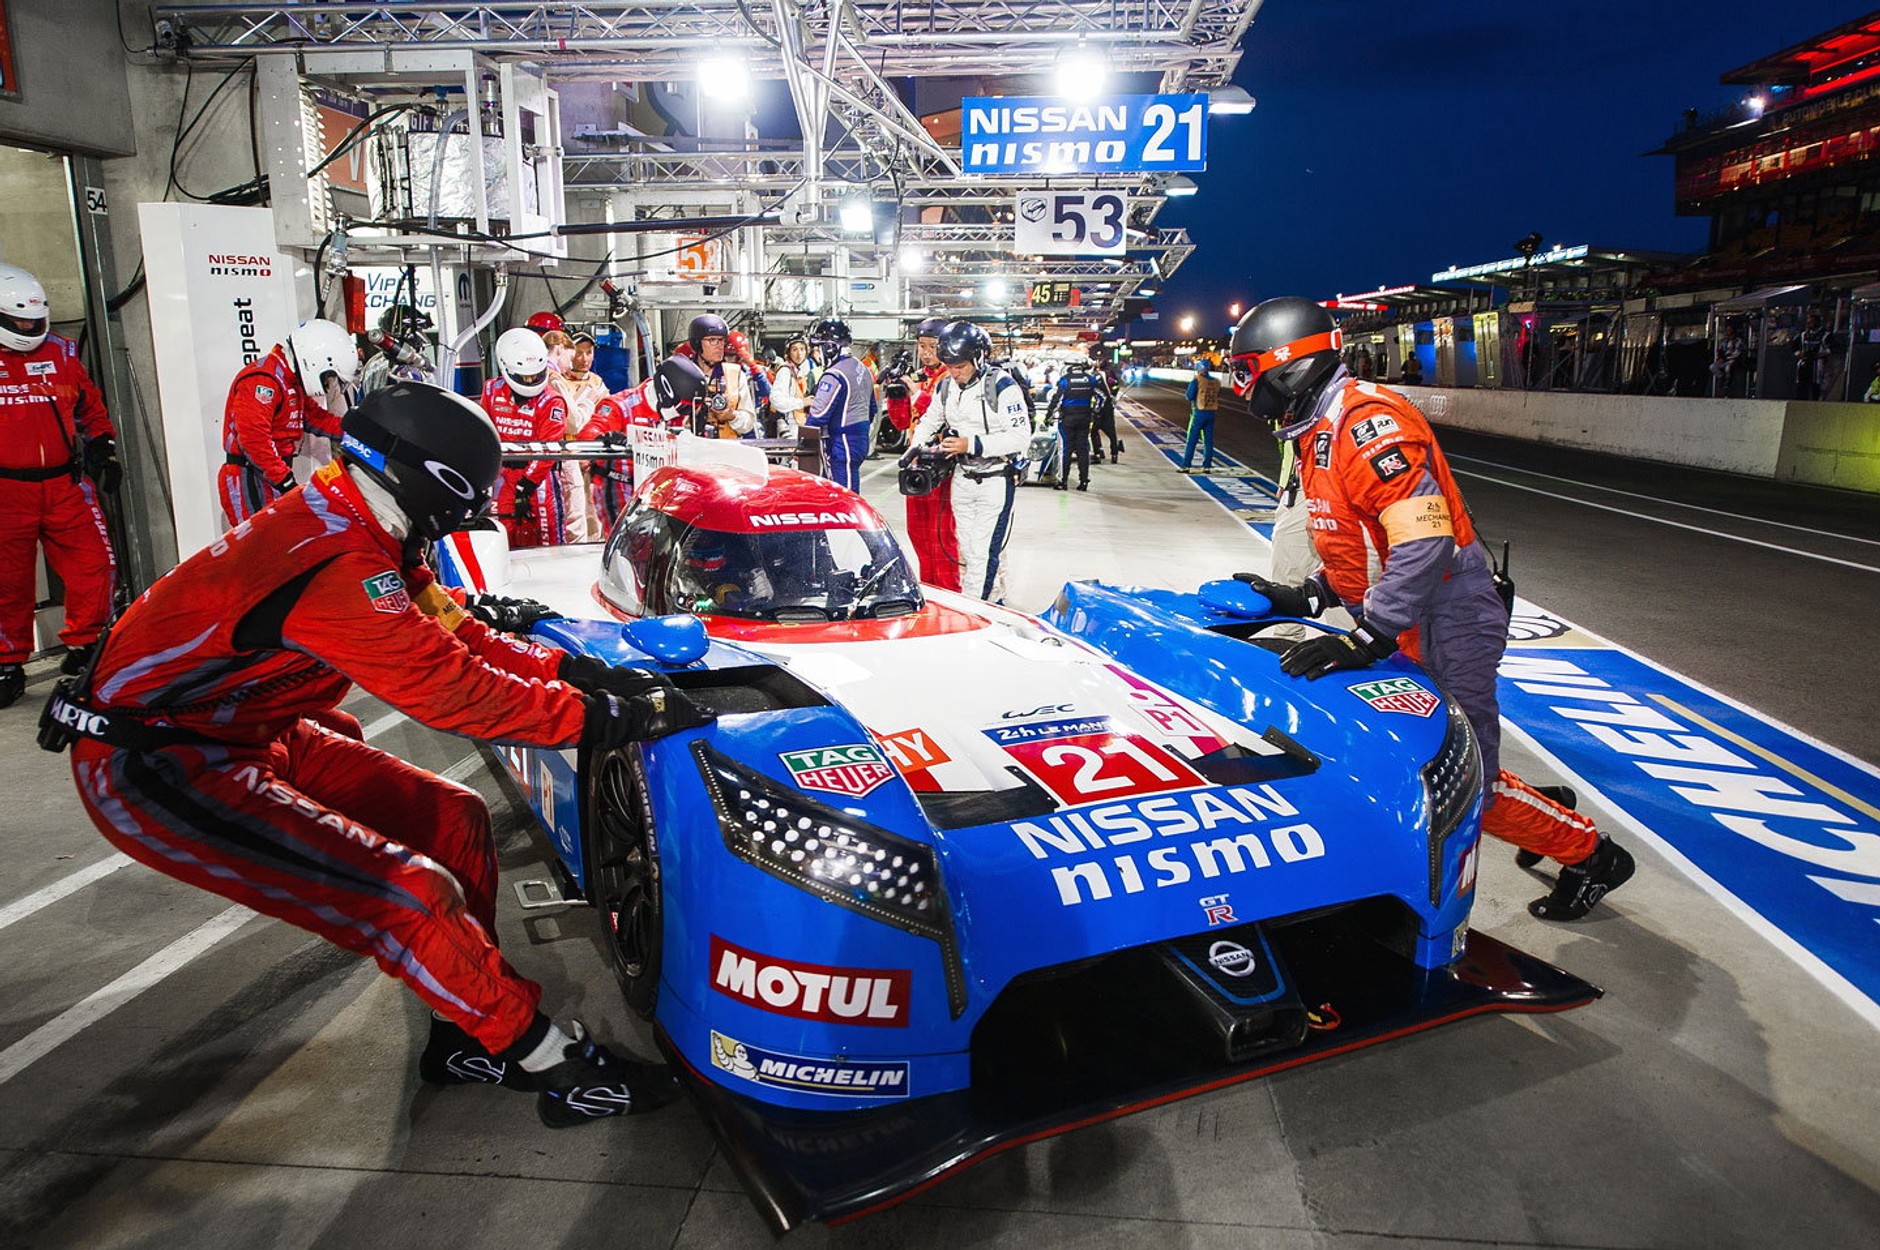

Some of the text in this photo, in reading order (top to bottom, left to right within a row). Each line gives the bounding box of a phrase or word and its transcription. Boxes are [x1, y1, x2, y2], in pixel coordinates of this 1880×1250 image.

[969, 105, 1127, 135] NISSAN
[1141, 103, 1203, 162] 21
[970, 140, 1127, 166] nismo
[87, 191, 107, 213] 54
[1051, 194, 1125, 249] 53
[208, 254, 271, 266] NISSAN
[210, 266, 271, 277] nismo
[1031, 284, 1051, 303] 45
[749, 511, 858, 528] NISSAN
[371, 574, 401, 595] TAG
[1355, 679, 1418, 697] TAG
[1371, 691, 1436, 714] HEUER
[1150, 708, 1203, 732] P1
[790, 747, 872, 768] TAG
[1040, 738, 1180, 795] 21
[800, 763, 889, 792] HEUER
[232, 765, 379, 849] NISSAN
[1009, 784, 1301, 860] NISSAN
[1051, 823, 1326, 906] nismo
[1199, 893, 1230, 907] GT
[1203, 904, 1239, 927] R
[1213, 950, 1251, 965] NISSAN
[715, 949, 899, 1019] MOTUL
[759, 1059, 905, 1087] MICHELIN
